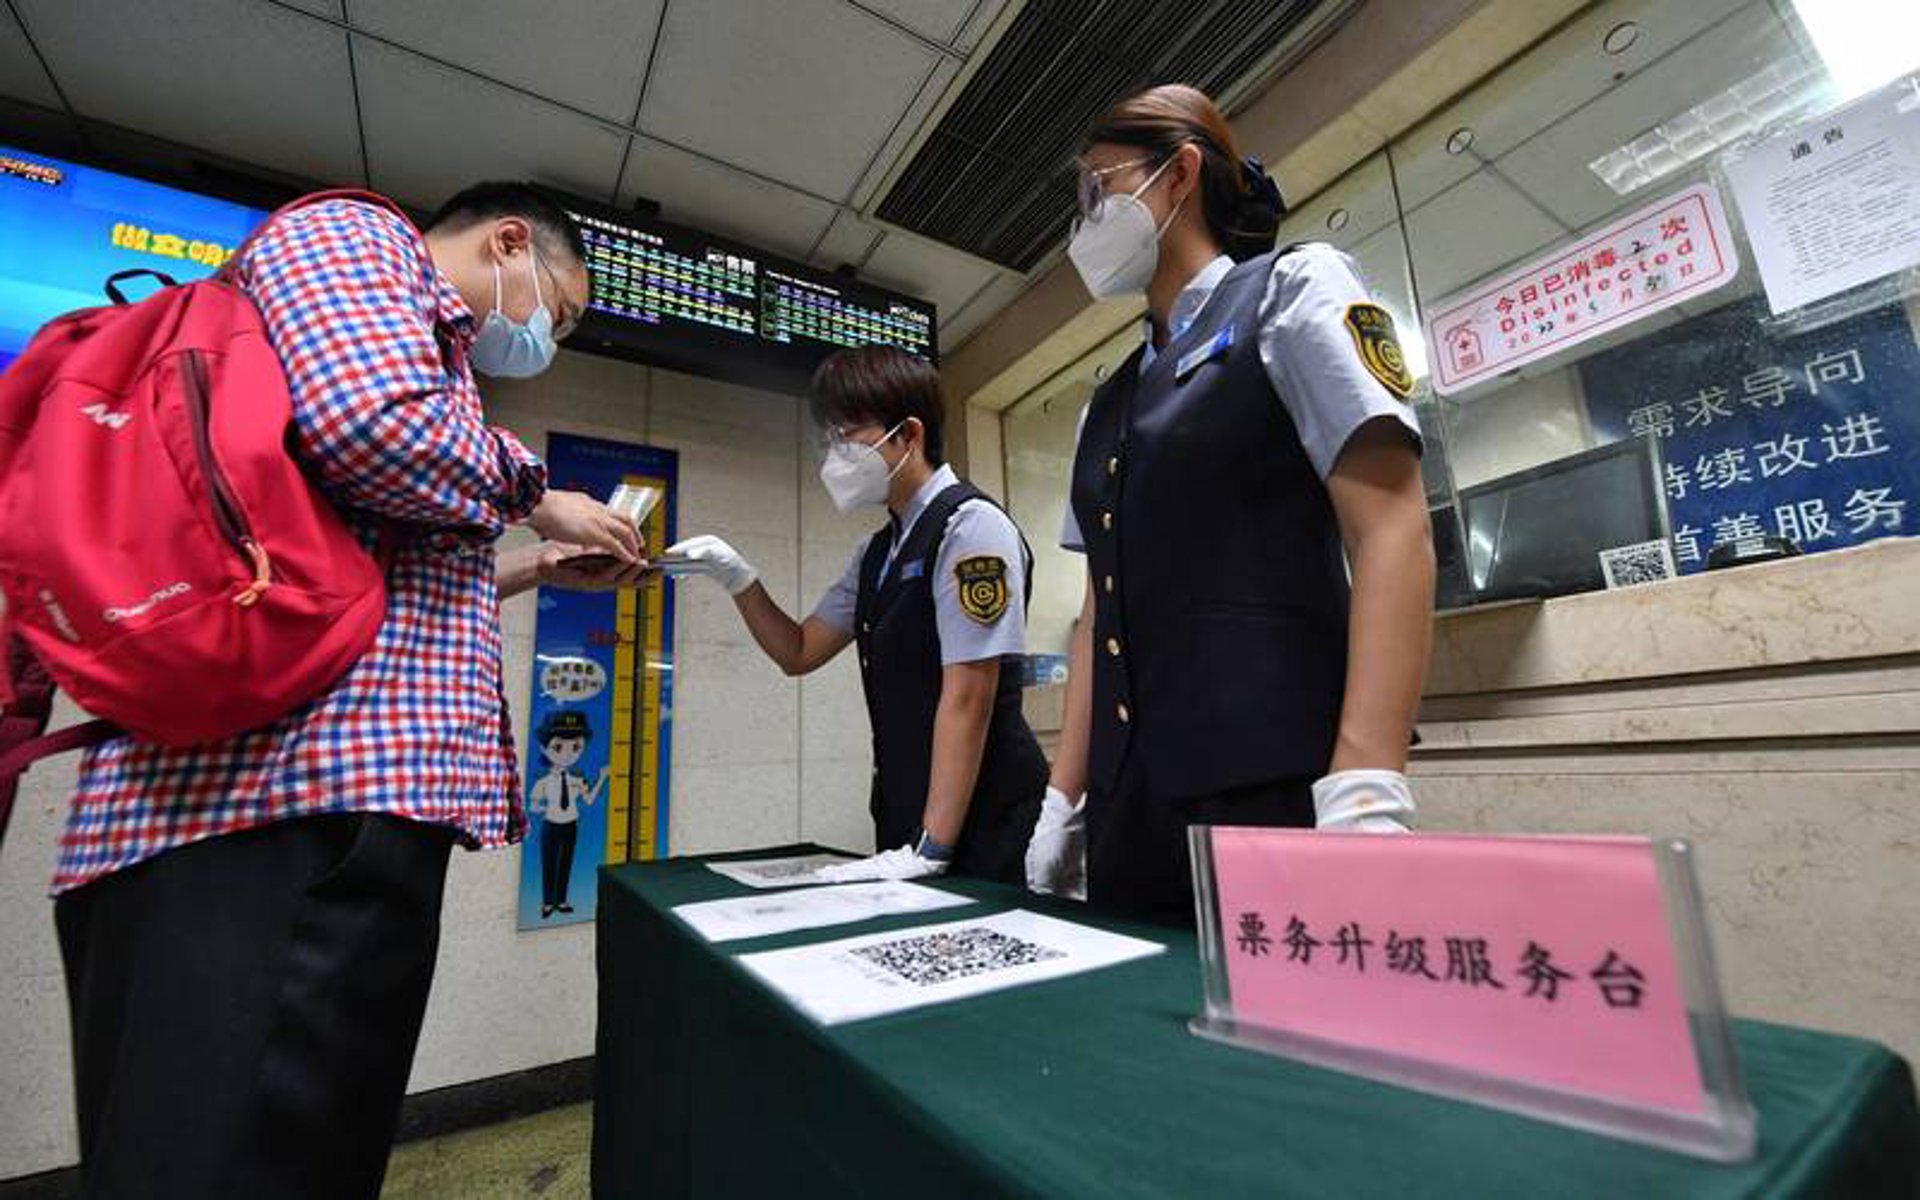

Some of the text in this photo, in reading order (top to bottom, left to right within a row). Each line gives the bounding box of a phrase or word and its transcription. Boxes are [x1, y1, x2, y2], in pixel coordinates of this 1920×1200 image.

[1627, 349, 1866, 438] 需求导向
[1236, 911, 1646, 1009] 票务升级服务台
